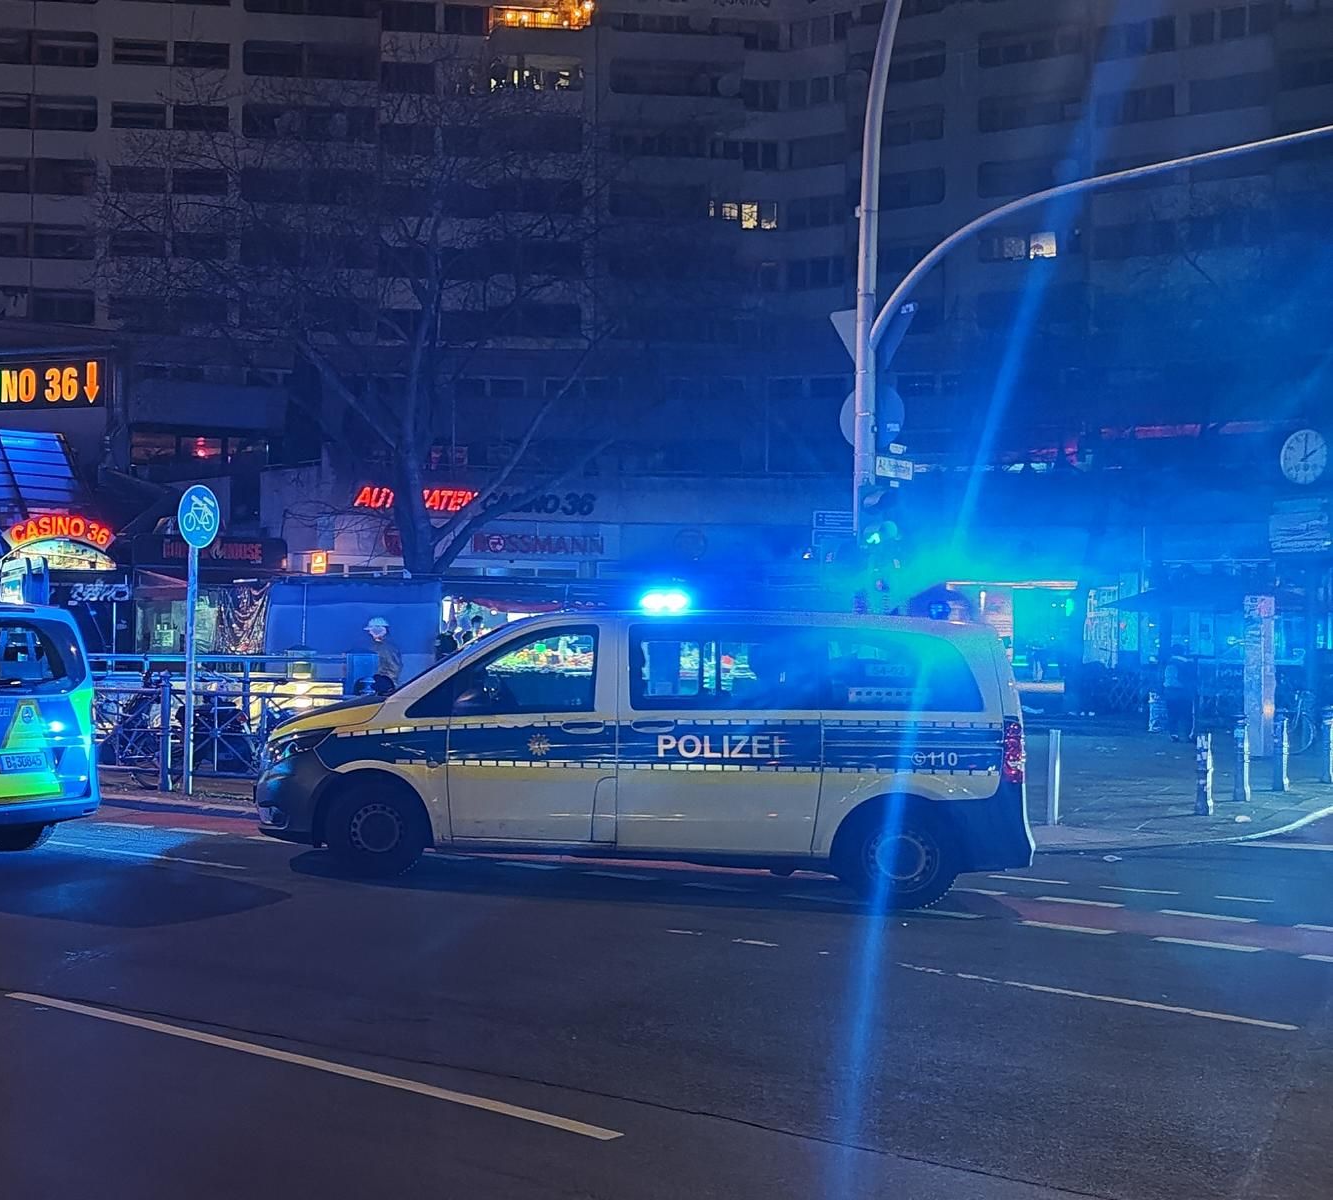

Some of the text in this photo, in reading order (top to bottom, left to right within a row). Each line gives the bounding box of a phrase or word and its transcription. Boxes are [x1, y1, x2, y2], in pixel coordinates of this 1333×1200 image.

[44, 366, 78, 402] 36
[561, 492, 597, 516] 36
[9, 515, 110, 545] CASINO 36
[657, 734, 781, 759] POLIZEI
[928, 751, 958, 767] 110
